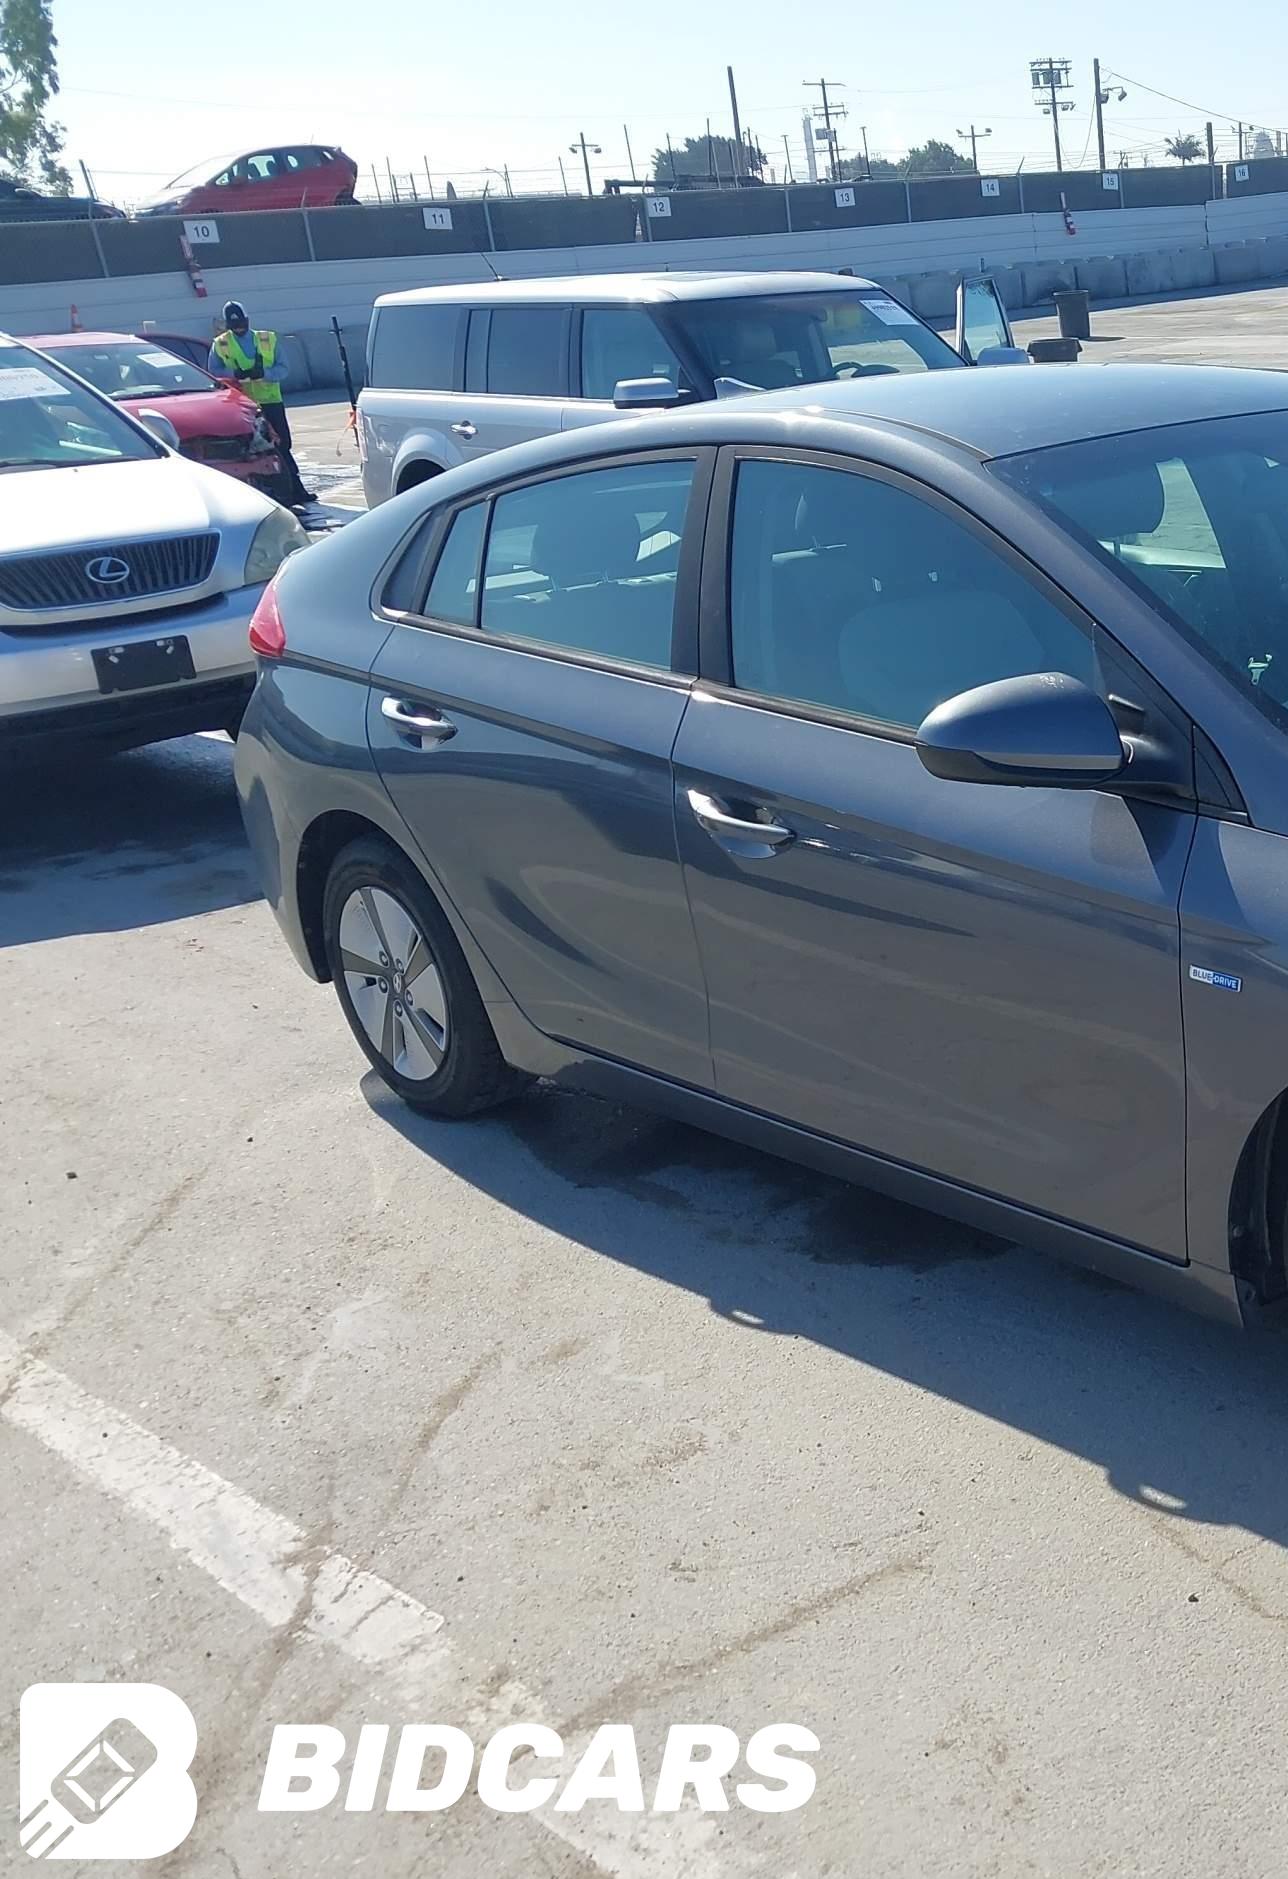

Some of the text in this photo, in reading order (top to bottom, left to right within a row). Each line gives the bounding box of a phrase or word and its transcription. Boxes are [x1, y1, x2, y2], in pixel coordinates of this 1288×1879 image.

[1107, 176, 1115, 186] 15
[986, 183, 995, 193] 14
[840, 192, 850, 203] 13
[653, 201, 665, 213] 12
[432, 213, 444, 225] 11
[193, 225, 210, 238] 10
[1192, 968, 1237, 989] BLUE DRIVE
